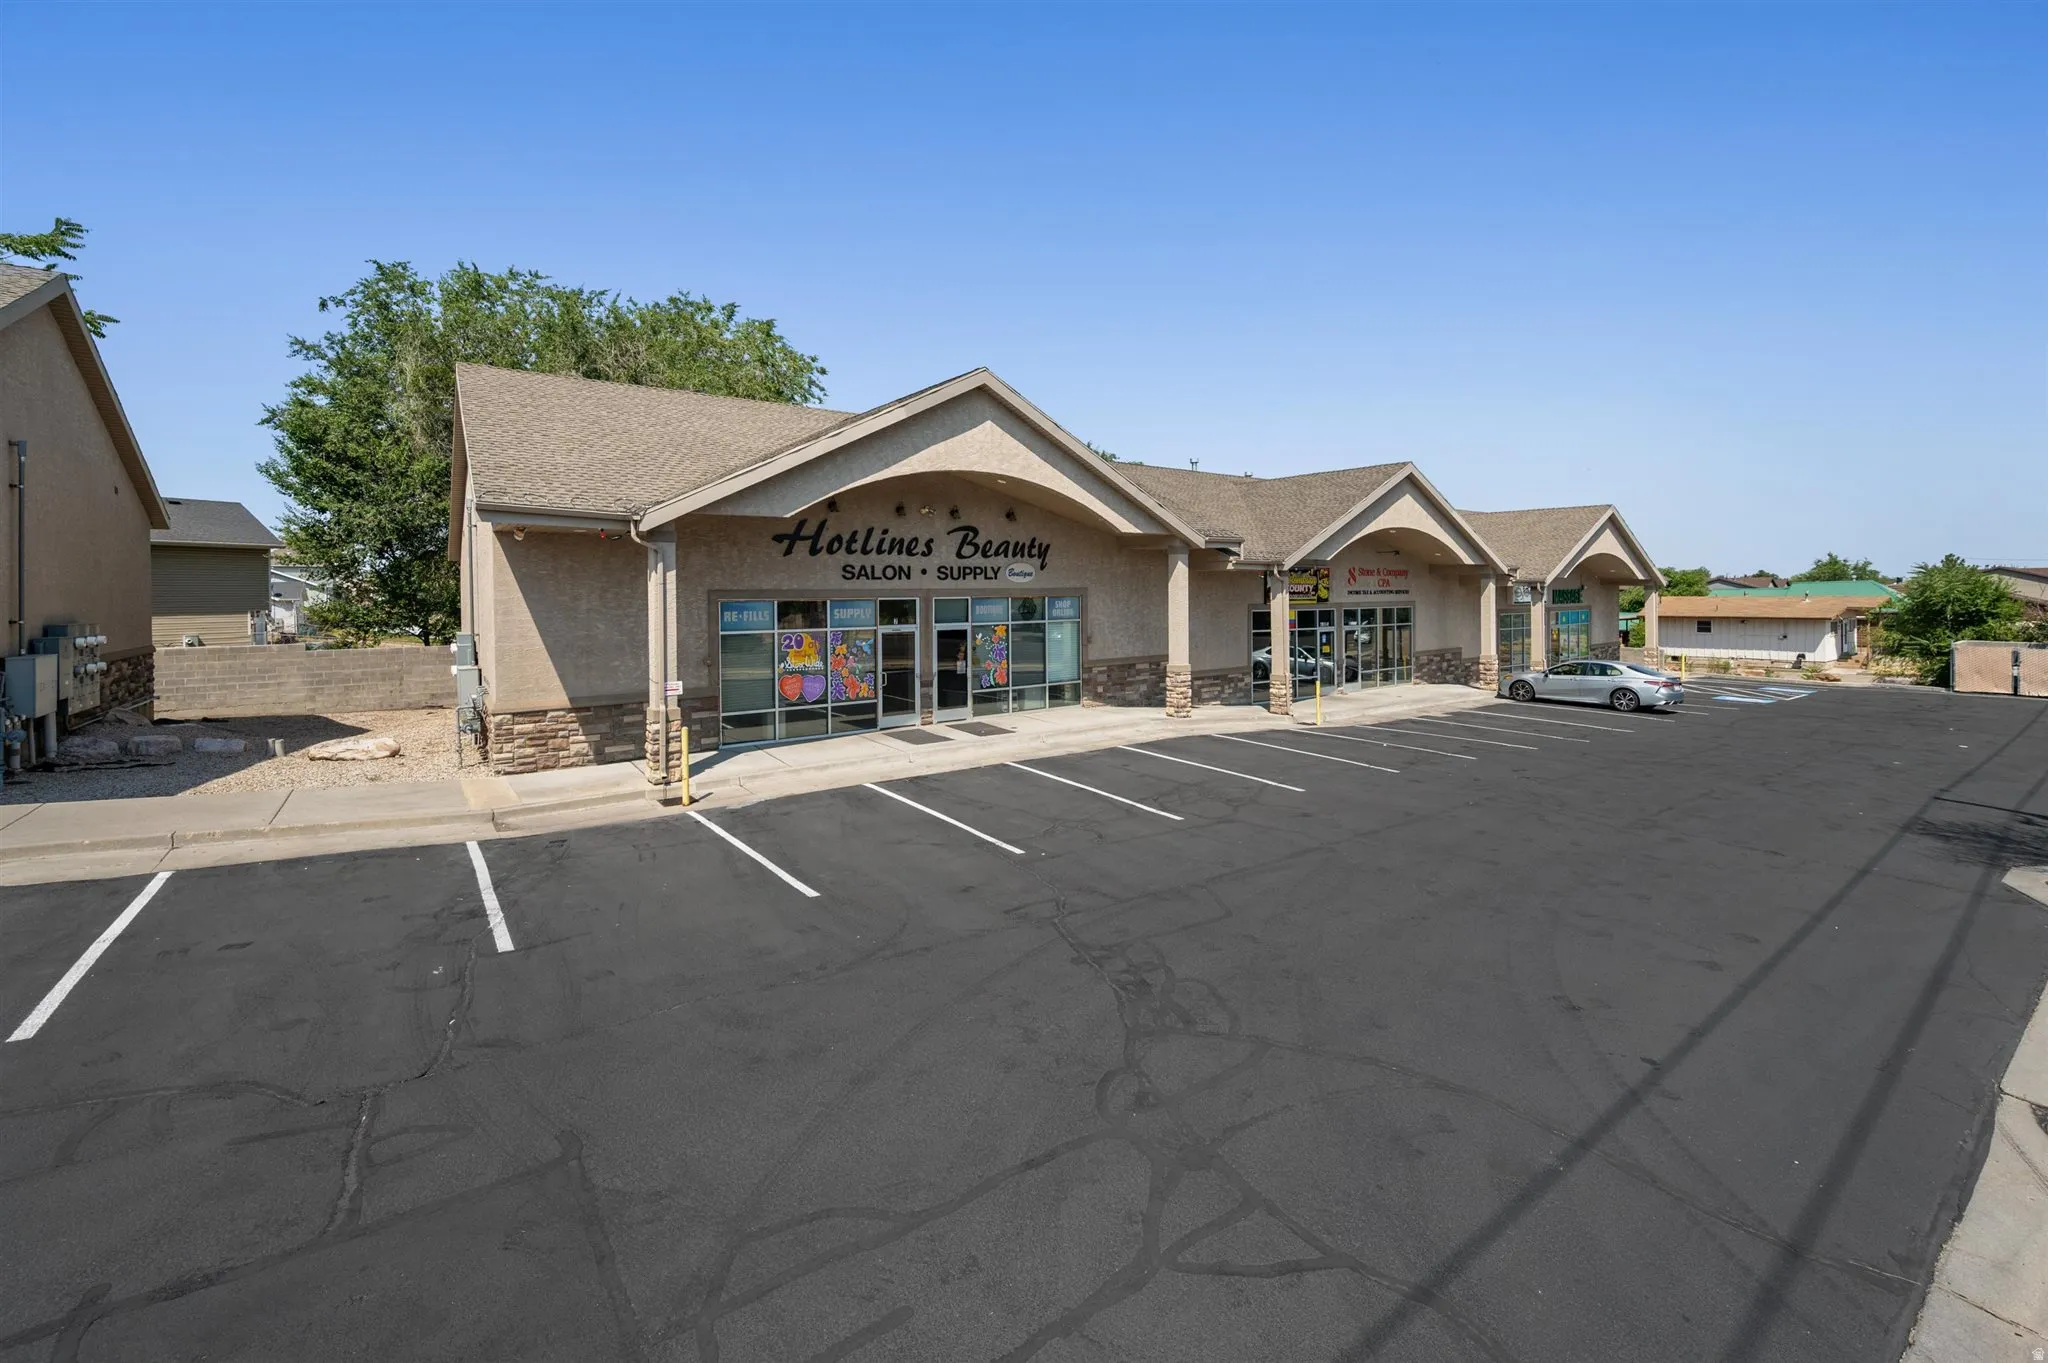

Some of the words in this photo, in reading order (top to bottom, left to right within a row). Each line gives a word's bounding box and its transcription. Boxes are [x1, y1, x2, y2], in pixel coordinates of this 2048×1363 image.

[772, 518, 934, 557] Hotlines
[947, 525, 1051, 570] Beauty
[841, 564, 911, 581] SALON
[936, 565, 1001, 581] SUPPLY
[1007, 567, 1034, 578] Boutique
[1376, 567, 1381, 576] &
[1382, 567, 1408, 580] Company
[1377, 578, 1390, 587] CPA
[1054, 600, 1072, 608] SHOP
[833, 608, 872, 619] SUPPLY
